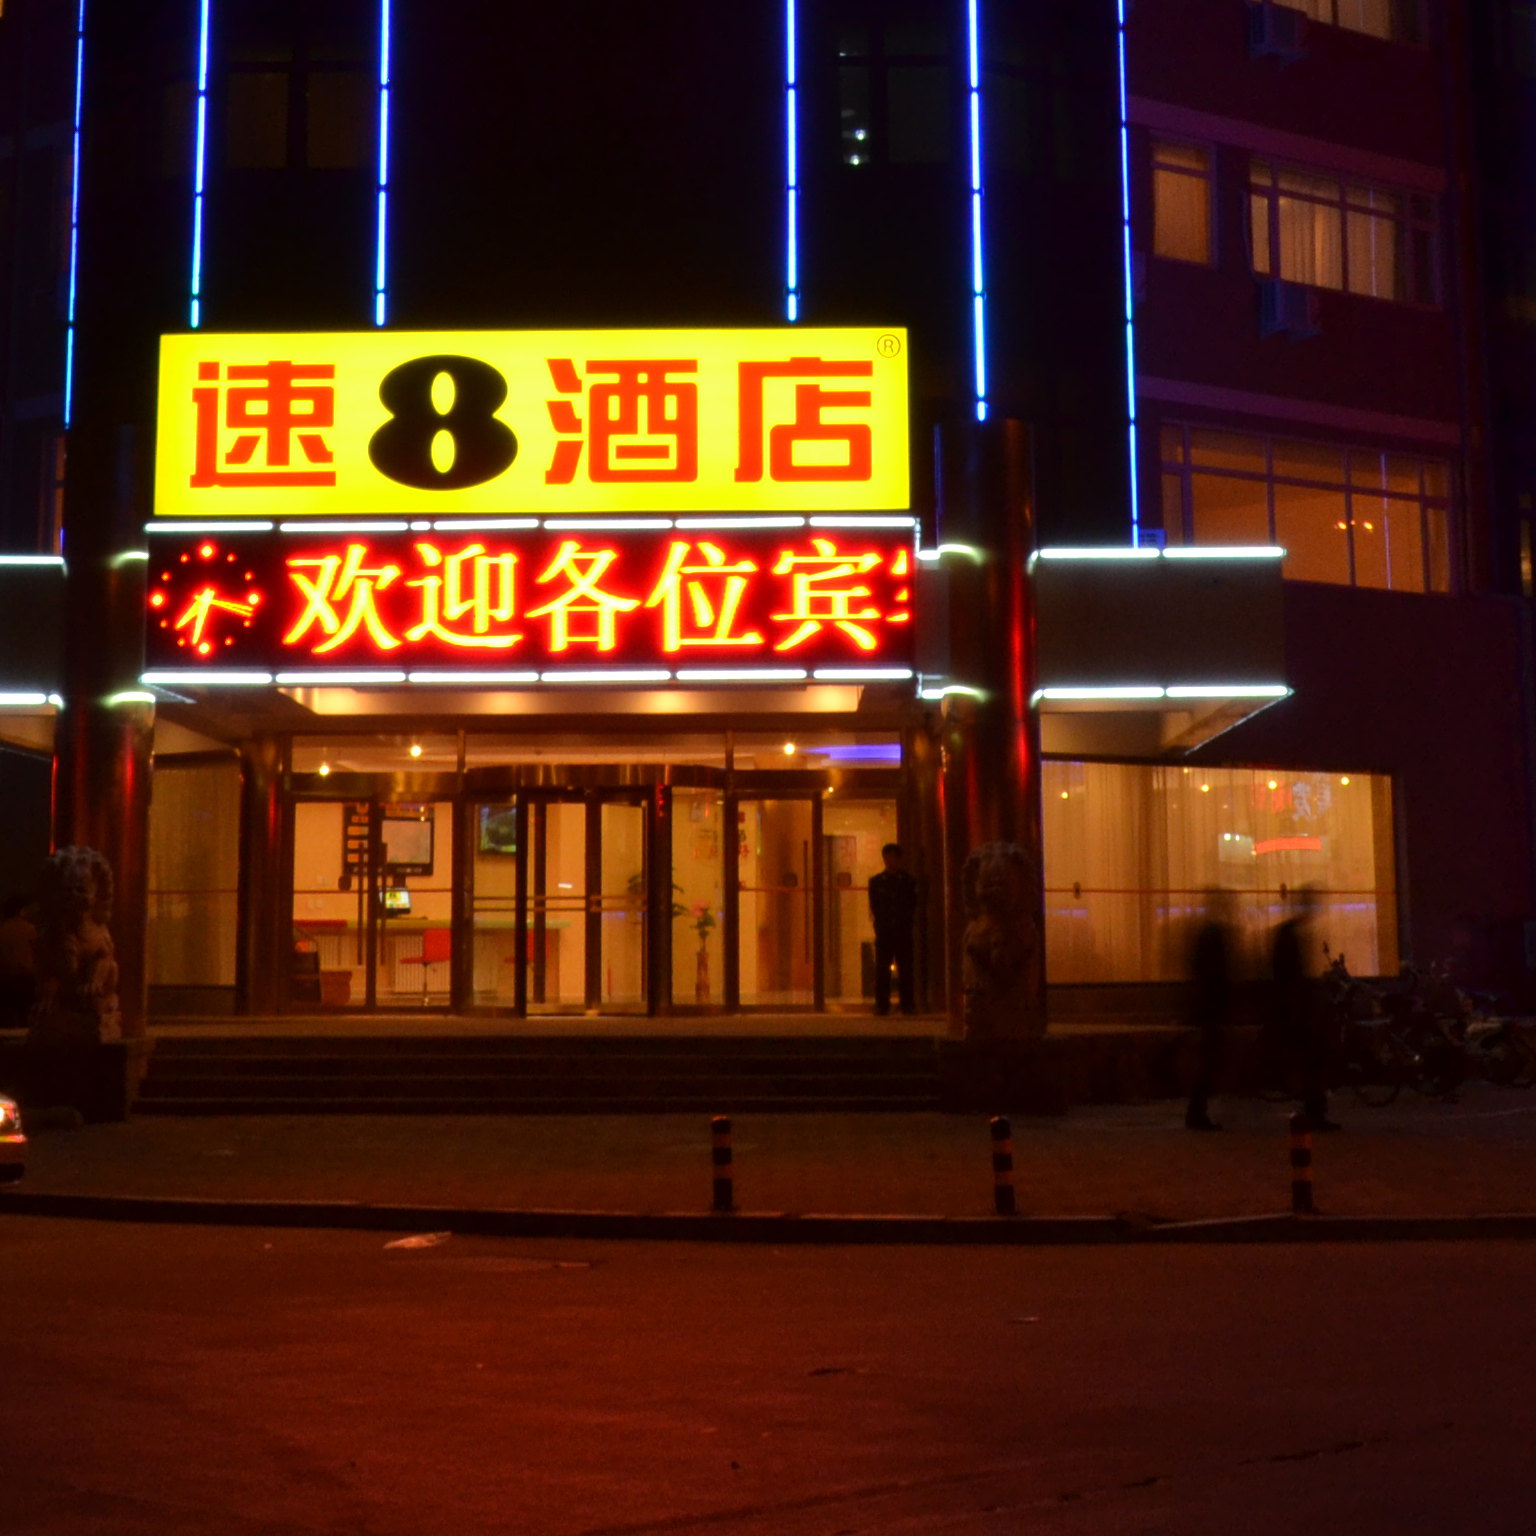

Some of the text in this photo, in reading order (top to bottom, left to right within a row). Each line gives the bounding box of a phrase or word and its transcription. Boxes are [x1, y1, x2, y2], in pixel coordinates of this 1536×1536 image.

[189, 353, 874, 492] 速8酒店
[281, 537, 910, 655] 欢迎各位宾
